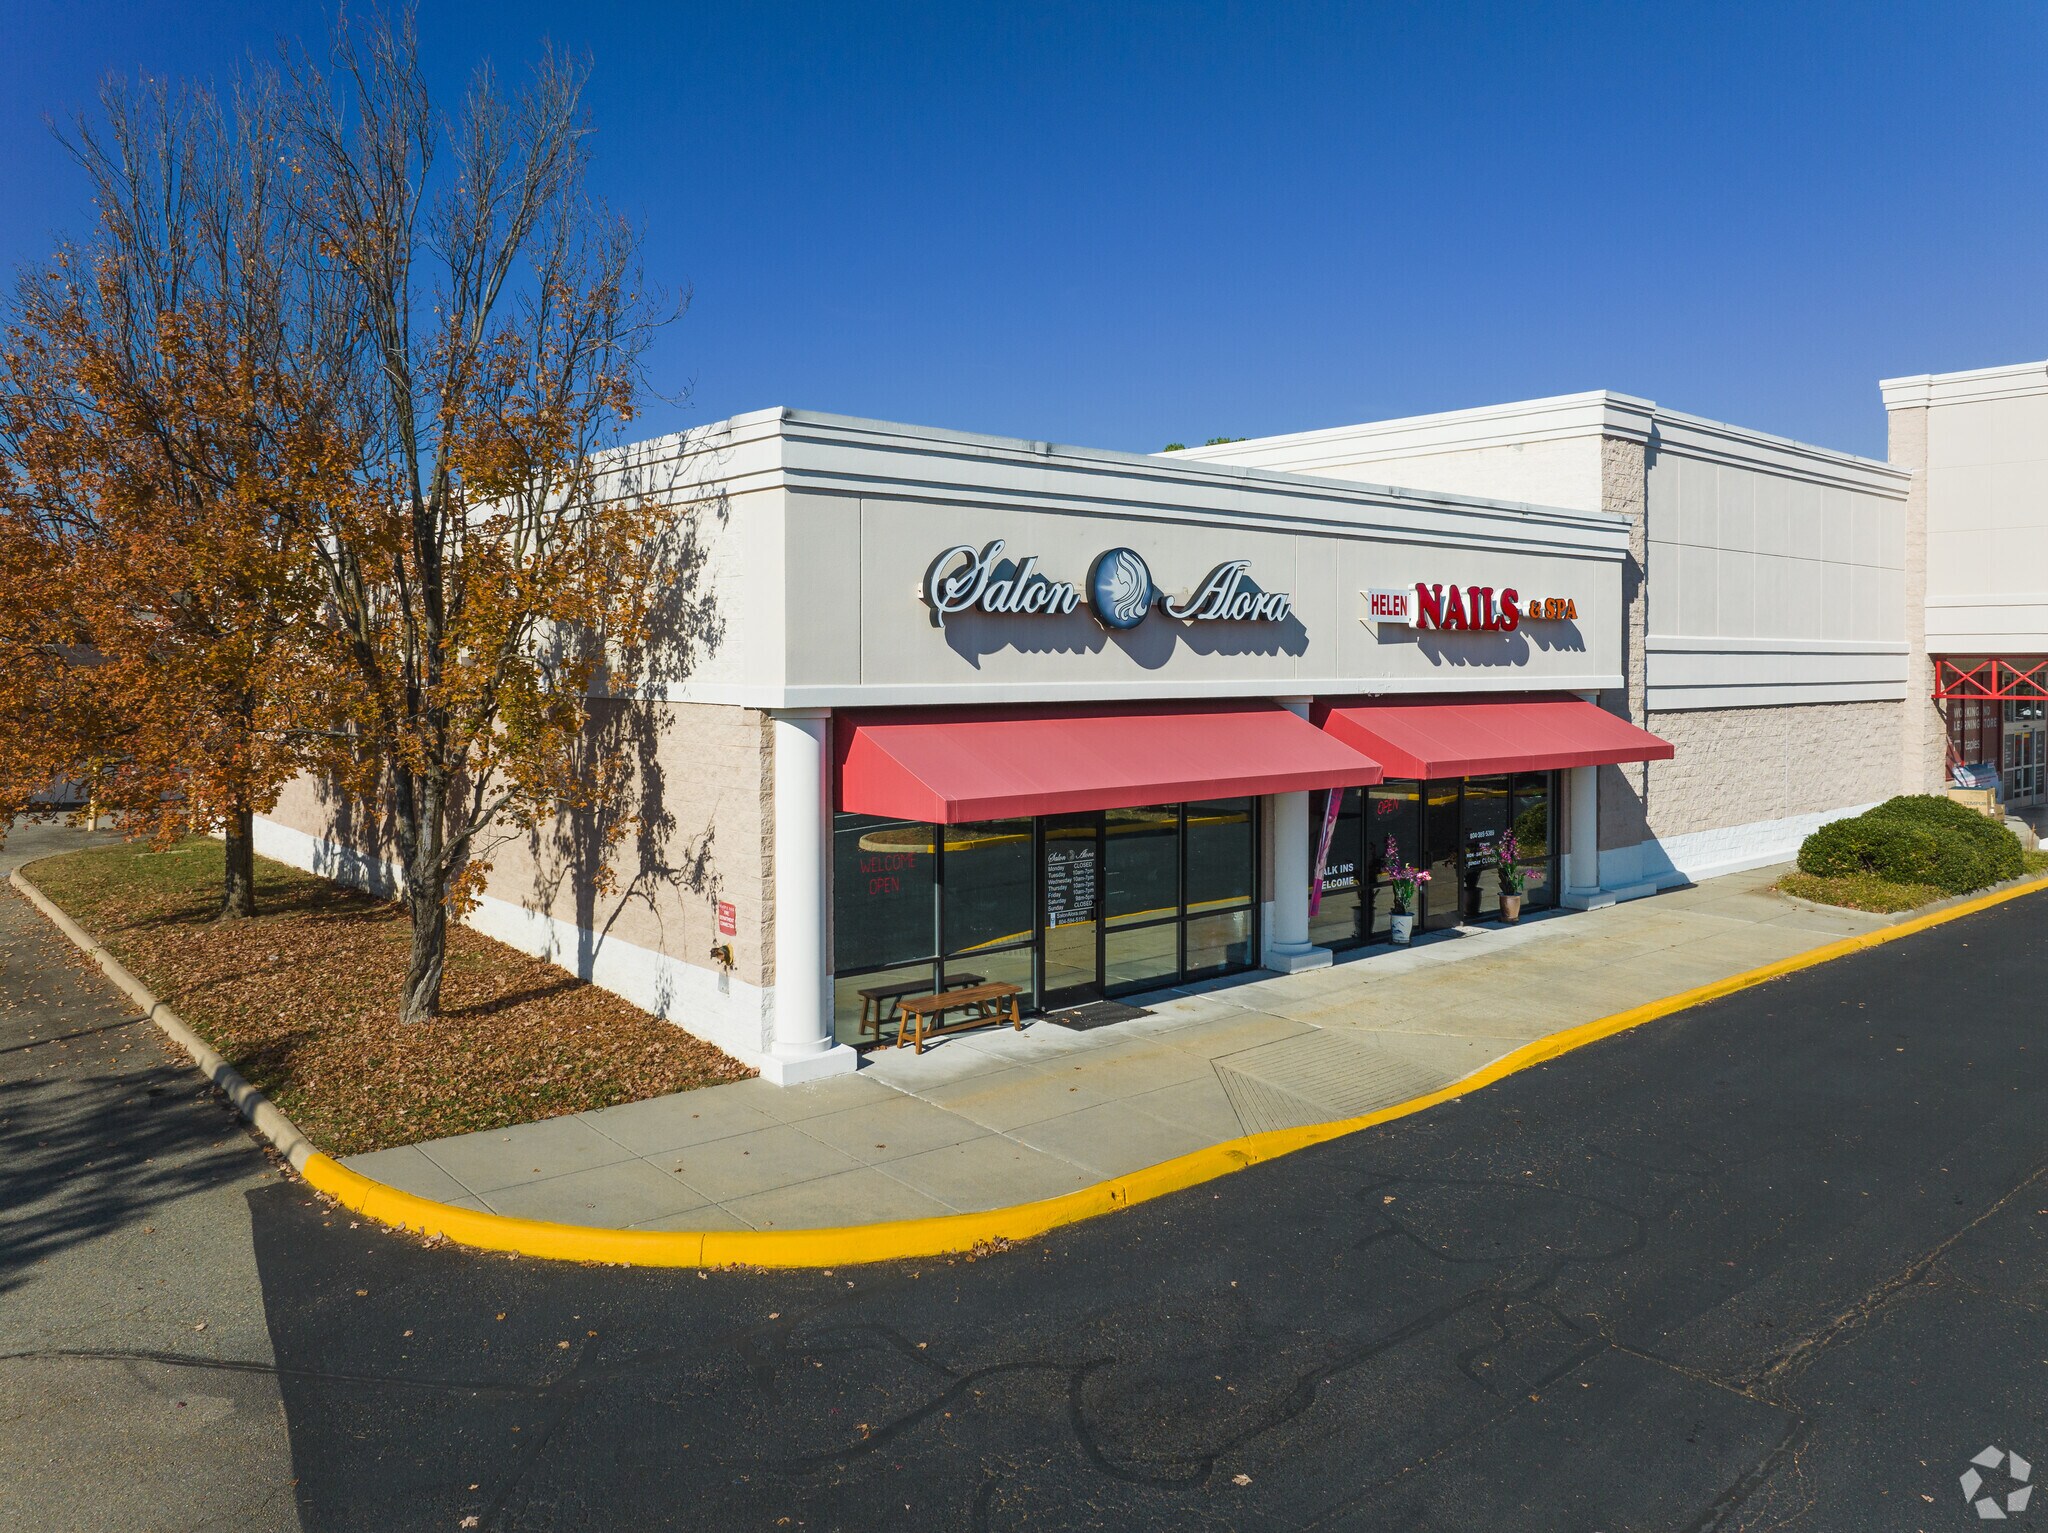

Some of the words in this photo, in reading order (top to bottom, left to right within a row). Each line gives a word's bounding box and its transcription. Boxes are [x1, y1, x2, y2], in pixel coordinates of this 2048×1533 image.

[925, 539, 1081, 628] Salon
[1162, 560, 1293, 622] Alora
[1371, 594, 1408, 617] HELEN
[1414, 583, 1520, 632] NAILS
[1528, 600, 1542, 619] &
[1544, 597, 1578, 620] SPA
[1984, 717, 1997, 728] TORE
[1377, 798, 1399, 815] OPEN
[861, 852, 917, 873] WELCOME
[1322, 865, 1339, 876] ALK
[1340, 863, 1354, 874] INS
[869, 877, 900, 895] OPEN
[1321, 876, 1355, 890] ELCOME
[1073, 900, 1093, 908] CLOSED
